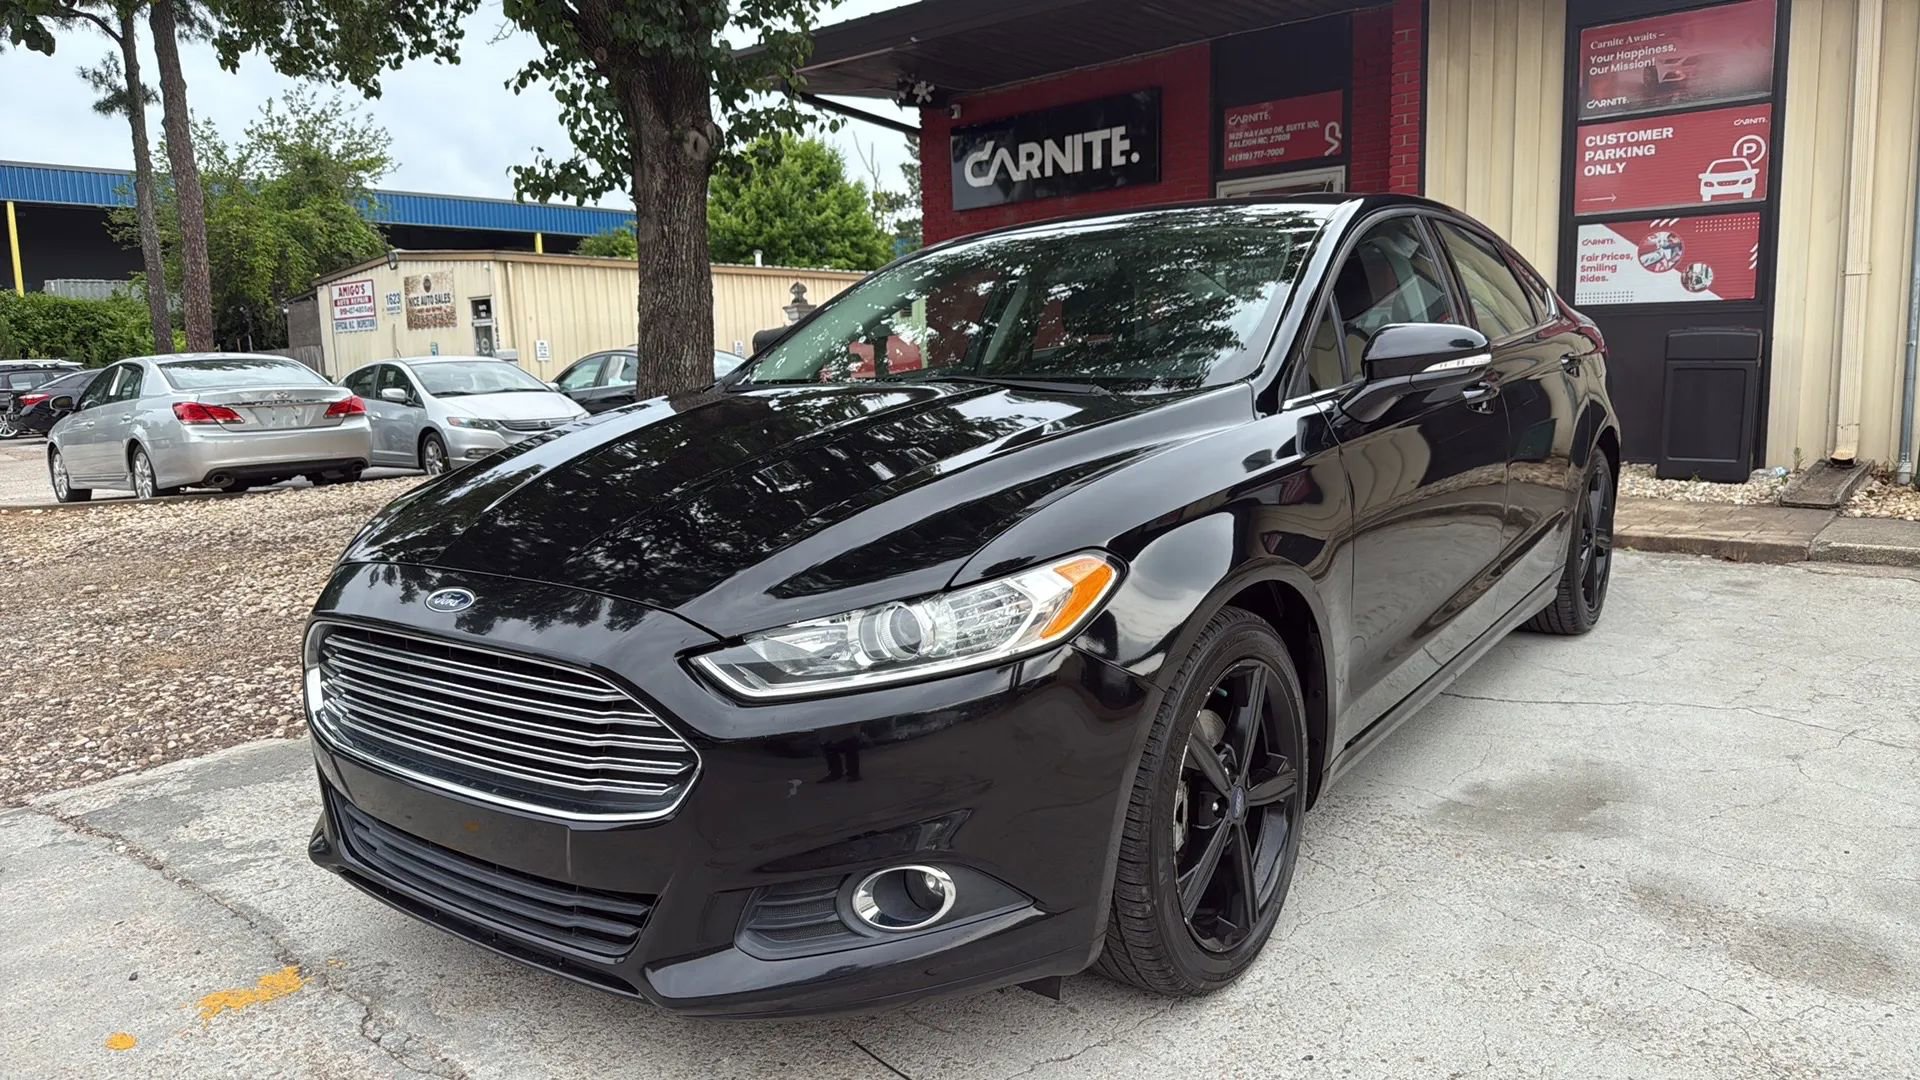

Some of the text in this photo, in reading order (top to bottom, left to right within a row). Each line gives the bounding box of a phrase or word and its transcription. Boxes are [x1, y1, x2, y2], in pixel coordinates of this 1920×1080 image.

[1590, 37, 1624, 50] Carnite
[1626, 31, 1657, 44] Awaits
[1590, 43, 1677, 65] Your Happiness,
[1589, 56, 1656, 76] Our Mission!
[1585, 127, 1674, 148] CUSTOMER
[1584, 144, 1656, 162] PARKING
[1742, 142, 1758, 157] P
[1584, 162, 1627, 177] ONLY
[1580, 251, 1633, 262] Fair Prices,
[1580, 263, 1617, 274] Smiling
[1580, 273, 1609, 283] Rides.
[338, 284, 366, 297] AMIGO'S
[385, 292, 401, 306] 1623
[420, 294, 434, 306] AUTO
[434, 292, 451, 305] SALES
